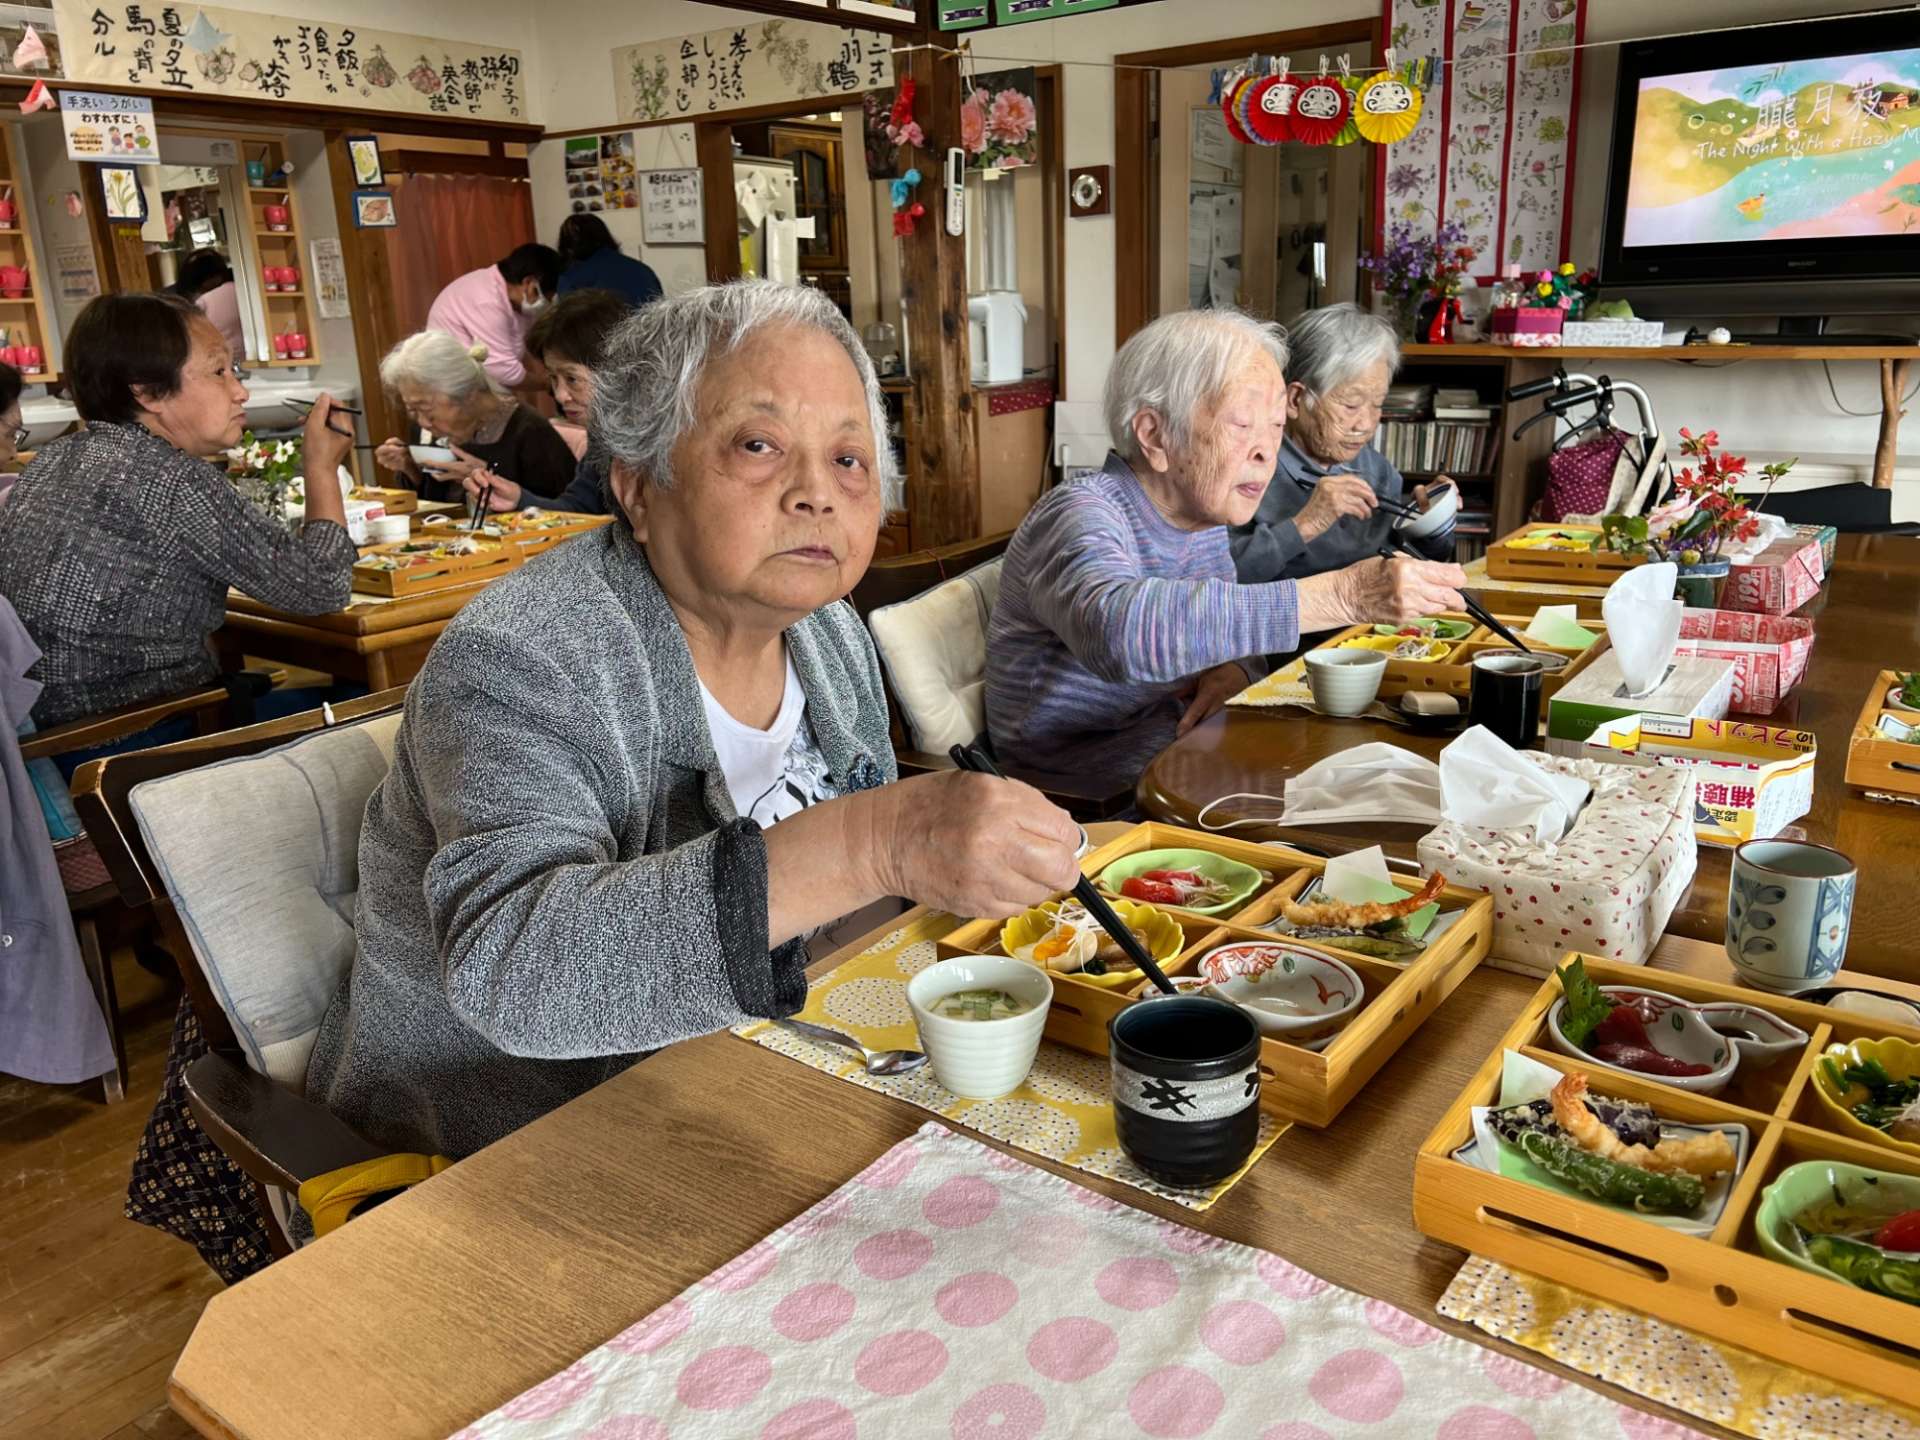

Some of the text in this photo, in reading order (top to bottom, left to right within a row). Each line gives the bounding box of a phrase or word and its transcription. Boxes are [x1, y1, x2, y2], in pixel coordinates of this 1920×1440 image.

[158, 8, 194, 90] 夏の夕立
[335, 28, 359, 87] 夕飯を
[868, 32, 888, 85] 二才の
[67, 96, 144, 110] 手洗い うがい
[1697, 141, 1728, 160] The
[1733, 139, 1779, 159] Night
[1832, 138, 1842, 148] a
